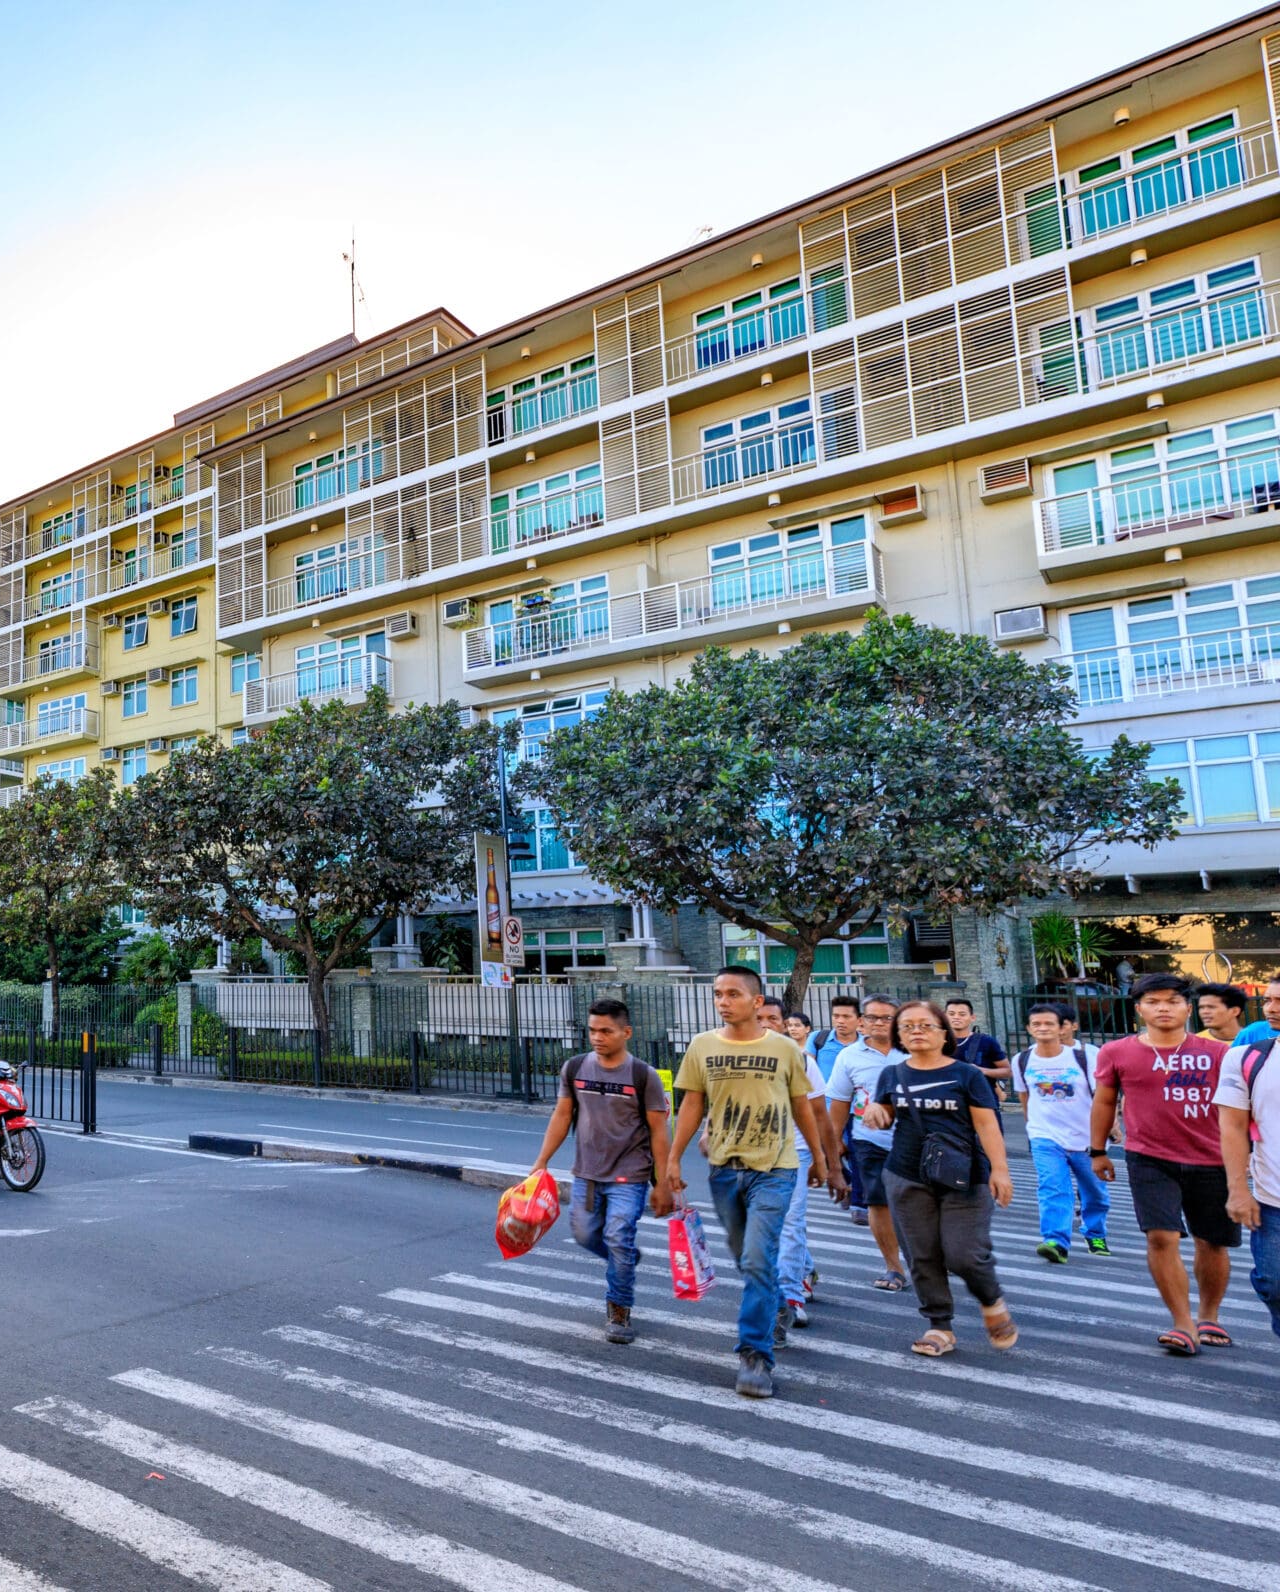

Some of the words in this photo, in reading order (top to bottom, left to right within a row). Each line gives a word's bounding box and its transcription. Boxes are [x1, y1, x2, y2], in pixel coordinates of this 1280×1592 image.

[1152, 1054, 1211, 1071] AERO
[1163, 1086, 1211, 1102] 1987
[924, 1098, 942, 1109] DO
[1184, 1103, 1210, 1119] NY
